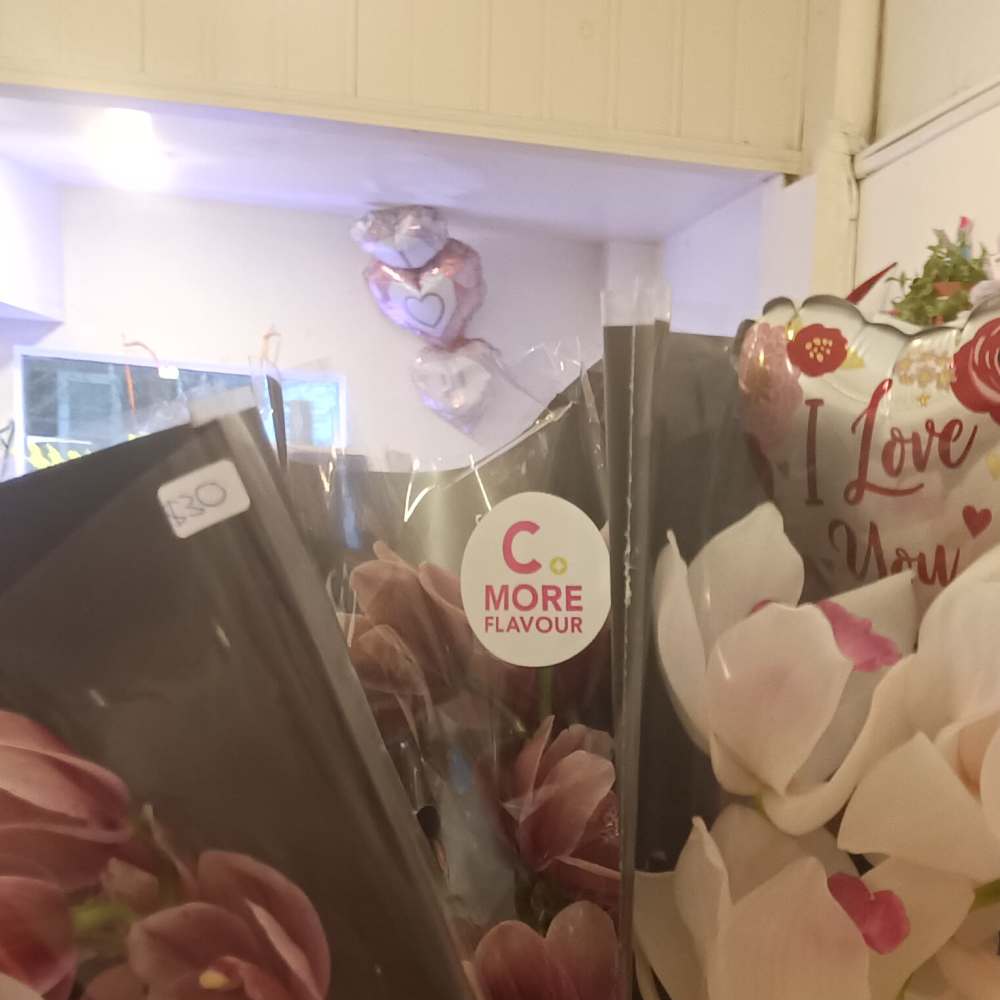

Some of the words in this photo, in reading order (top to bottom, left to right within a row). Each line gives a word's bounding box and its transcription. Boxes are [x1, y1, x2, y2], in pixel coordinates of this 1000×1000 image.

[804, 398, 825, 507] I
[843, 377, 978, 507] Love
[484, 583, 584, 613] MORE
[484, 616, 583, 635] FLAVOUR
